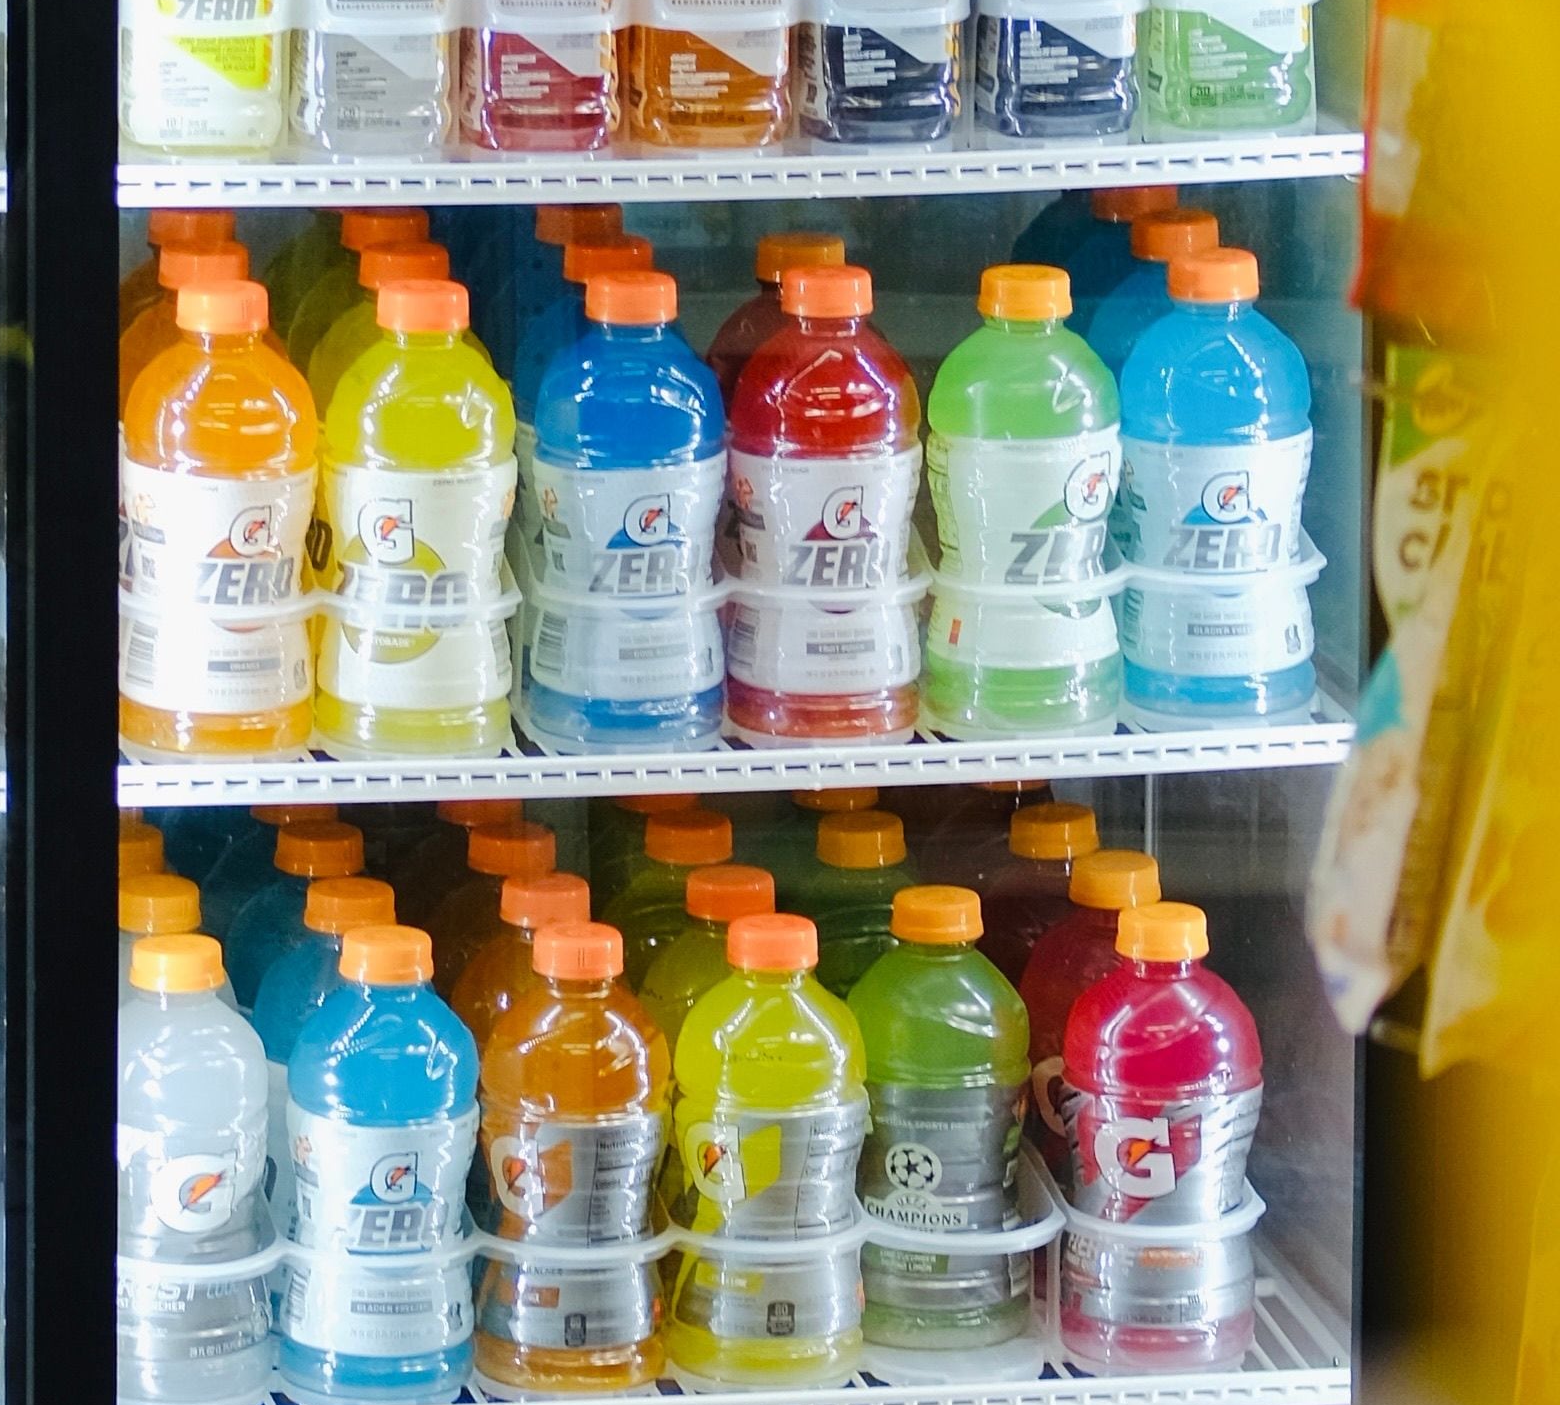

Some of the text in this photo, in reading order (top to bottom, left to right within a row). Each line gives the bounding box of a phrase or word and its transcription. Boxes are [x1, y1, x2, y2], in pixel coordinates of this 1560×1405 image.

[821, 485, 865, 541] G
[1064, 451, 1112, 522] G
[1201, 470, 1250, 525] G
[358, 498, 416, 565] G
[624, 494, 671, 547] G
[1162, 523, 1283, 571] ZERO
[194, 558, 295, 606] ZERO
[781, 542, 892, 588] ZERO
[370, 1152, 418, 1204] G
[1094, 1118, 1177, 1199] G
[867, 1202, 962, 1227] CHAMPIONS
